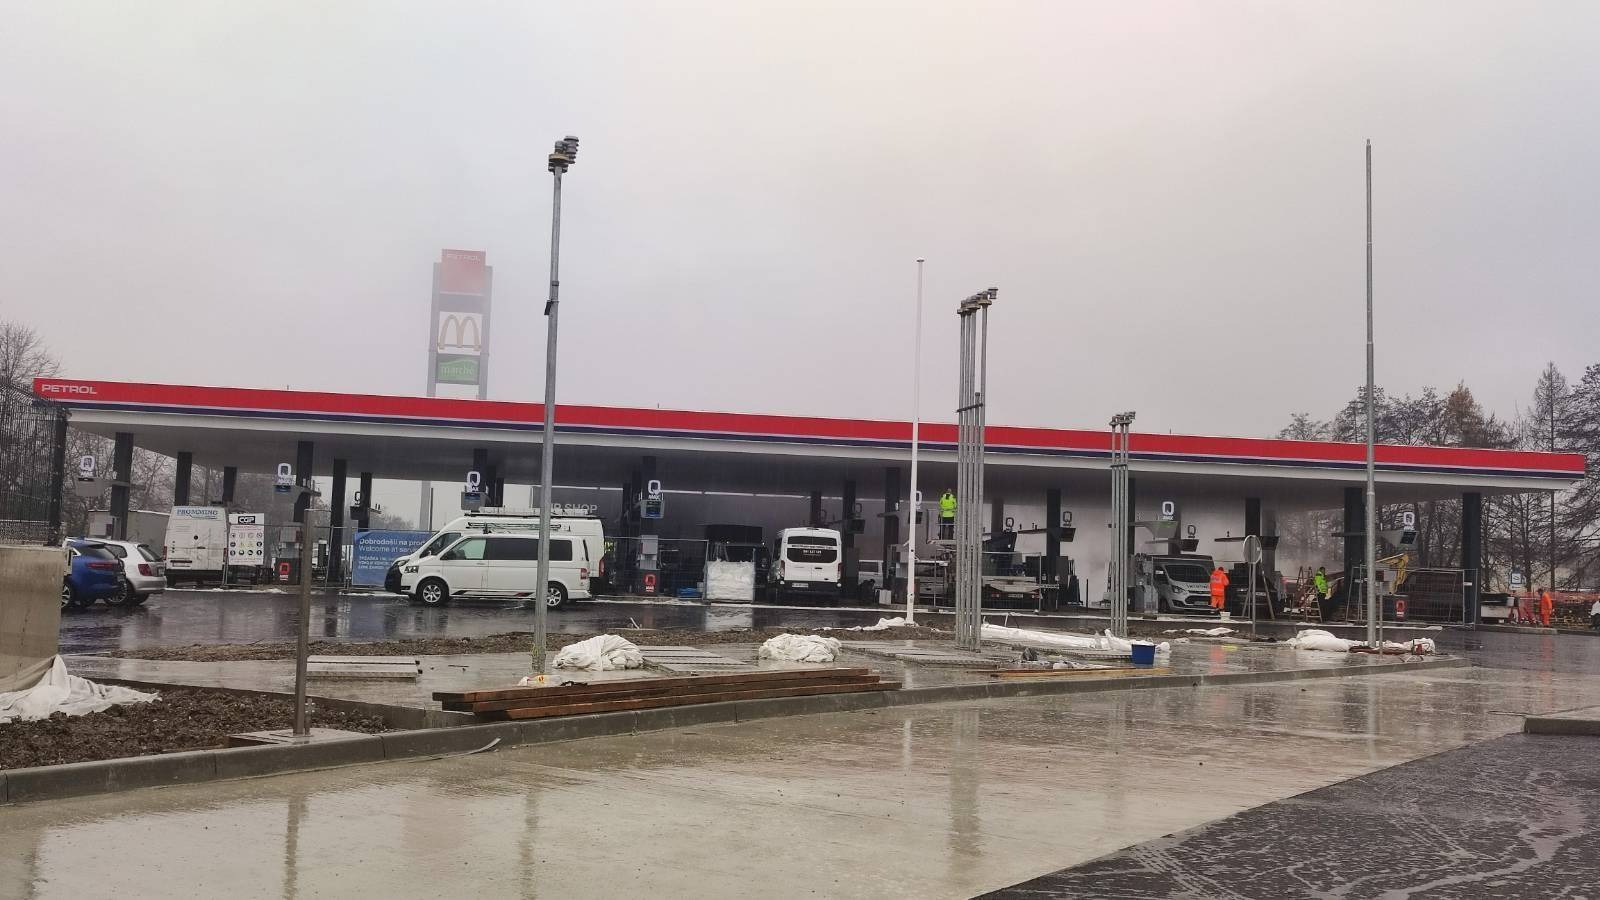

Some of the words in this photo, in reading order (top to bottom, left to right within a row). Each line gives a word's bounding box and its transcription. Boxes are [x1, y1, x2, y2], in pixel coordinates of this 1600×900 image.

[41, 384, 98, 395] PETROL
[648, 479, 661, 495] Q
[1162, 501, 1175, 516] Q
